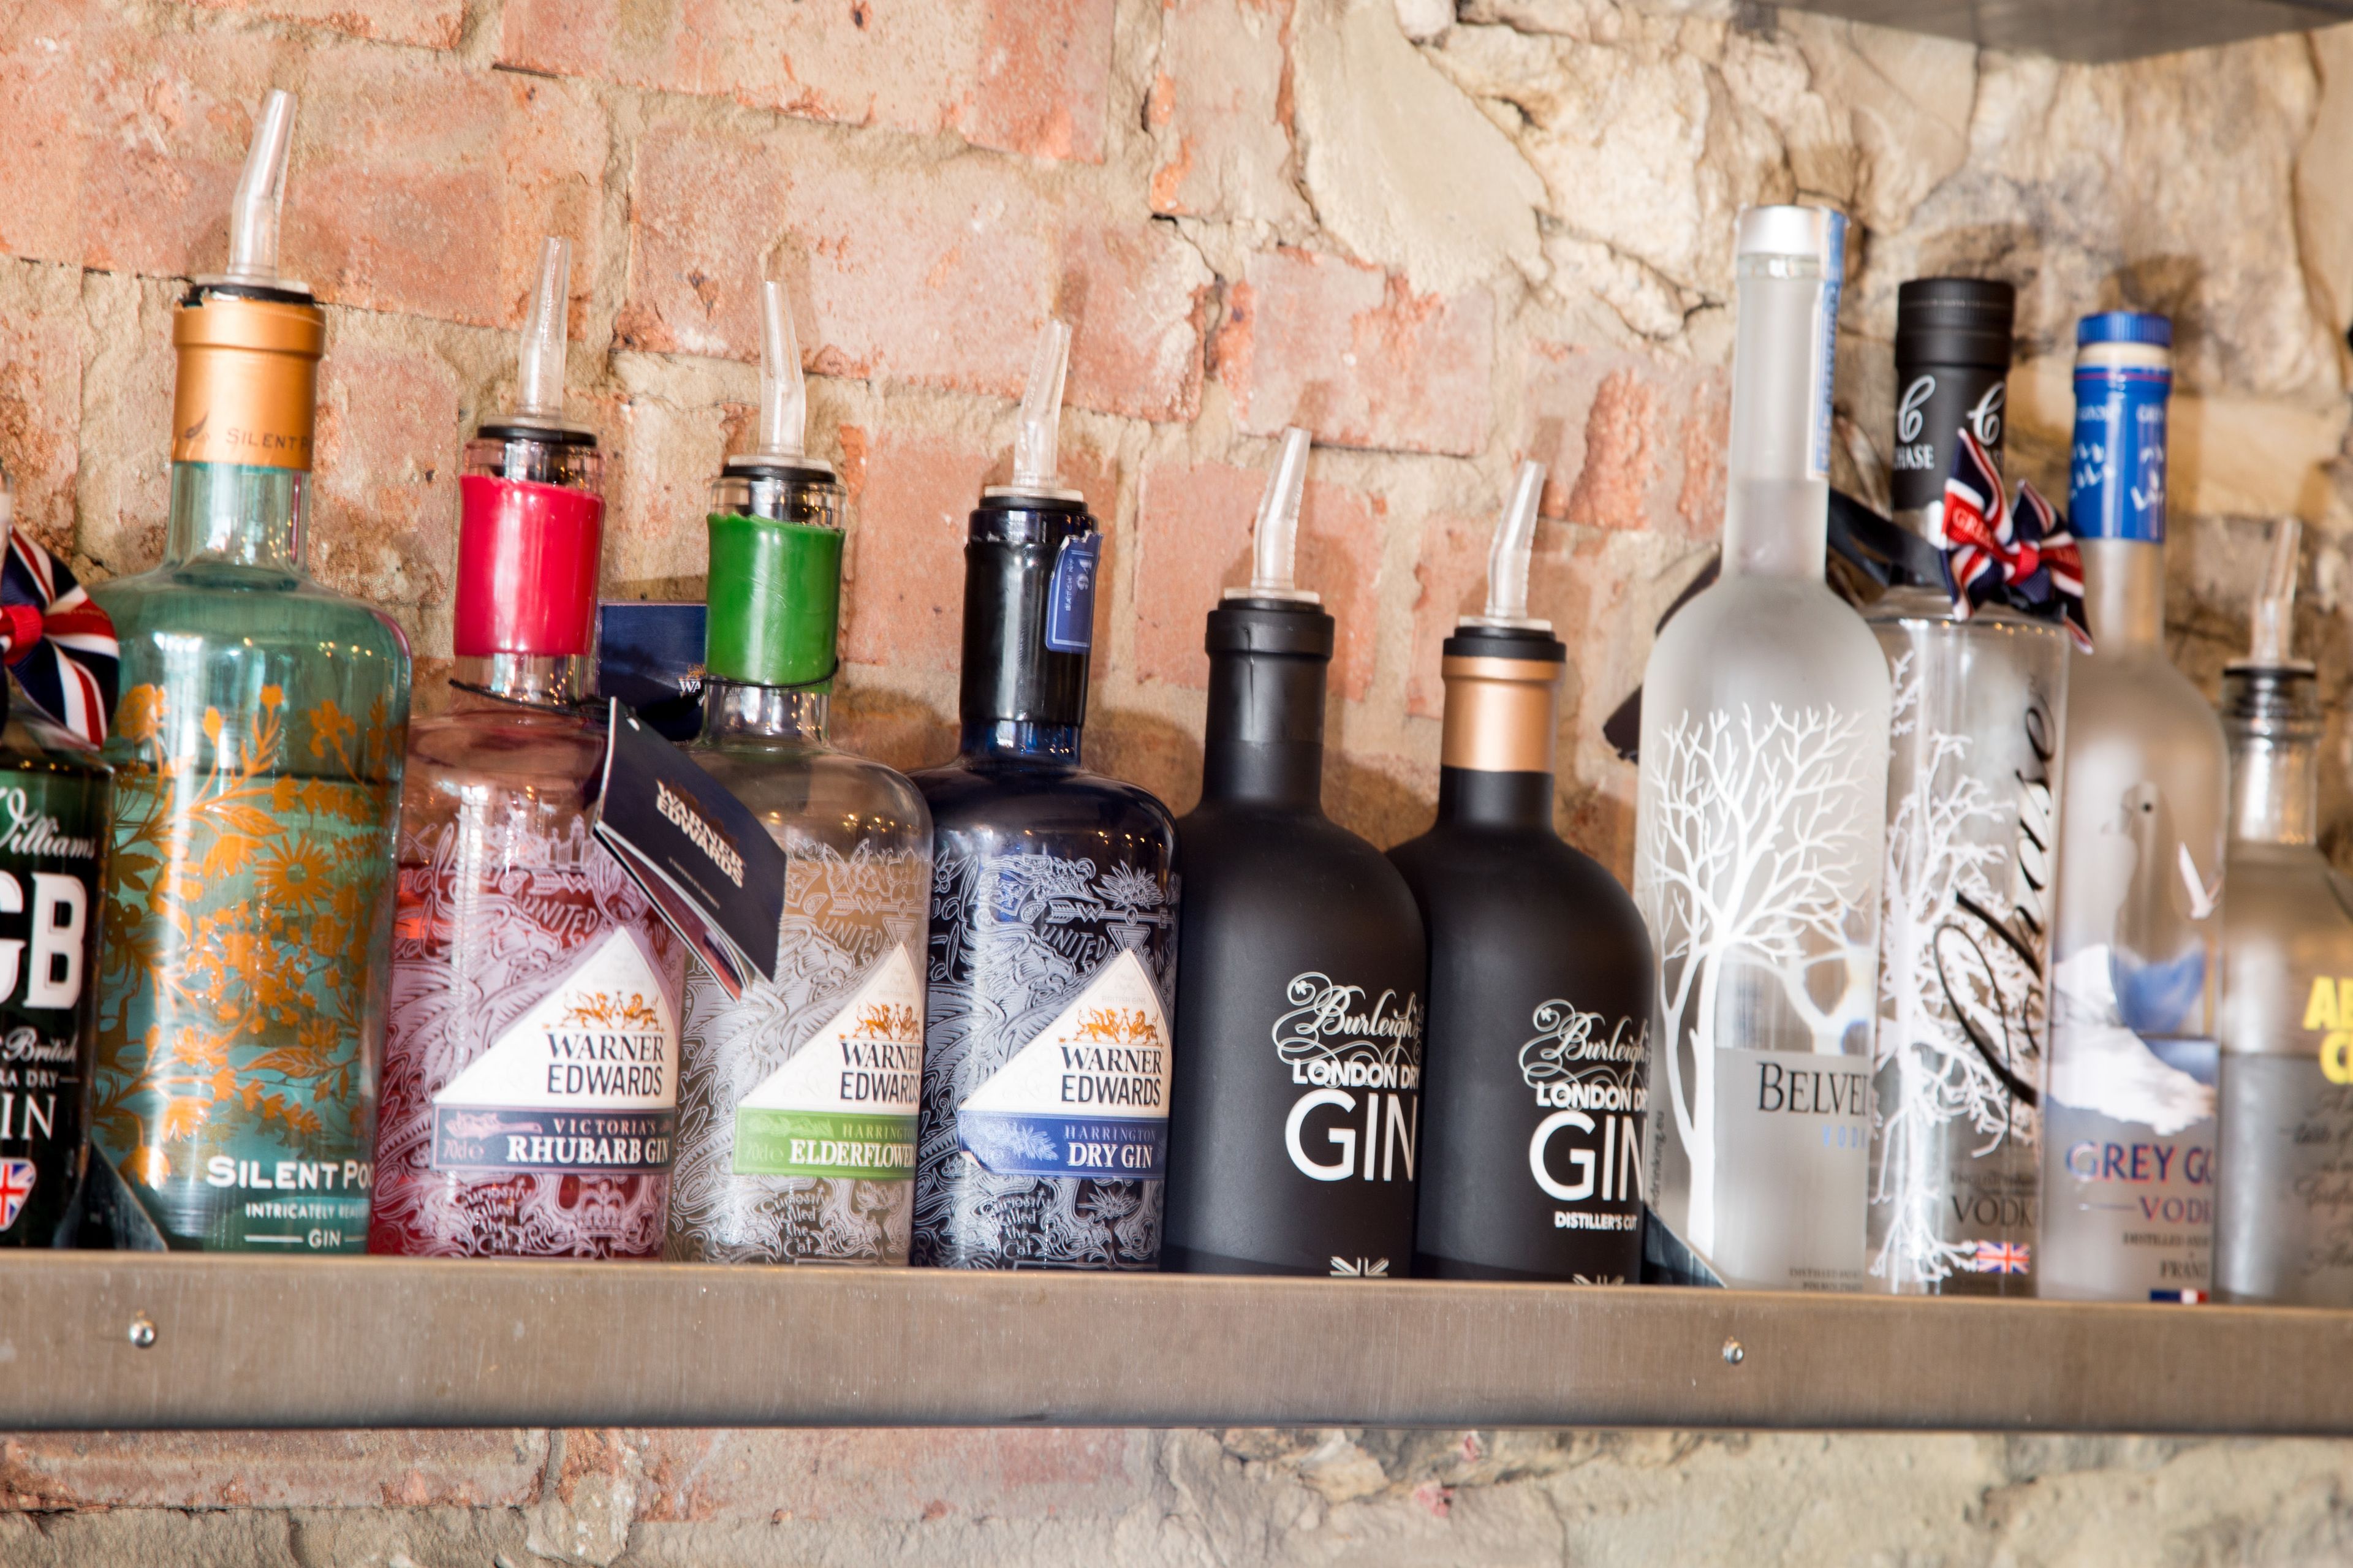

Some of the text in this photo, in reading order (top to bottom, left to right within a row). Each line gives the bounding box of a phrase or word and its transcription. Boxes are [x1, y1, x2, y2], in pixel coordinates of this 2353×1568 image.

[226, 428, 298, 452] SILENT
[1893, 444, 1934, 470] HASE
[656, 778, 747, 870] WARNER
[656, 793, 744, 888] EDWARDS
[522, 895, 598, 947] UNITED
[822, 917, 884, 962] UNITED
[1040, 924, 1107, 967] UNITED
[545, 1031, 665, 1063] WARNER
[841, 1042, 921, 1071] WARNER
[1060, 1046, 1163, 1076] WARNER
[26, 1069, 59, 1088] DRY
[547, 1064, 664, 1098] EDWARDS
[840, 1071, 920, 1104] EDWARDS
[1292, 1058, 1420, 1089] LONDON DRY
[1756, 1061, 1871, 1116] BELVE
[1061, 1075, 1161, 1107] EDWARDS
[1536, 1080, 1632, 1112] LONDON
[0, 1092, 57, 1141] IN
[553, 1117, 657, 1136] VICTORIA'S
[506, 1134, 670, 1164] RHUBARB GIN
[1064, 1124, 1157, 1142] HARRINGTON
[1285, 1088, 1418, 1182] GIN
[1822, 1125, 1868, 1149] VOD
[1066, 1142, 1153, 1168] DRY GIN
[1528, 1110, 1648, 1202] GIN
[2065, 1140, 2178, 1182] GREY
[207, 1156, 339, 1190] SILENT
[245, 1202, 335, 1220] INTRICATELY
[1554, 1211, 1638, 1231] DISTILLER'S CUT
[1951, 1194, 2036, 1228] VODK
[308, 1227, 342, 1249] GIN
